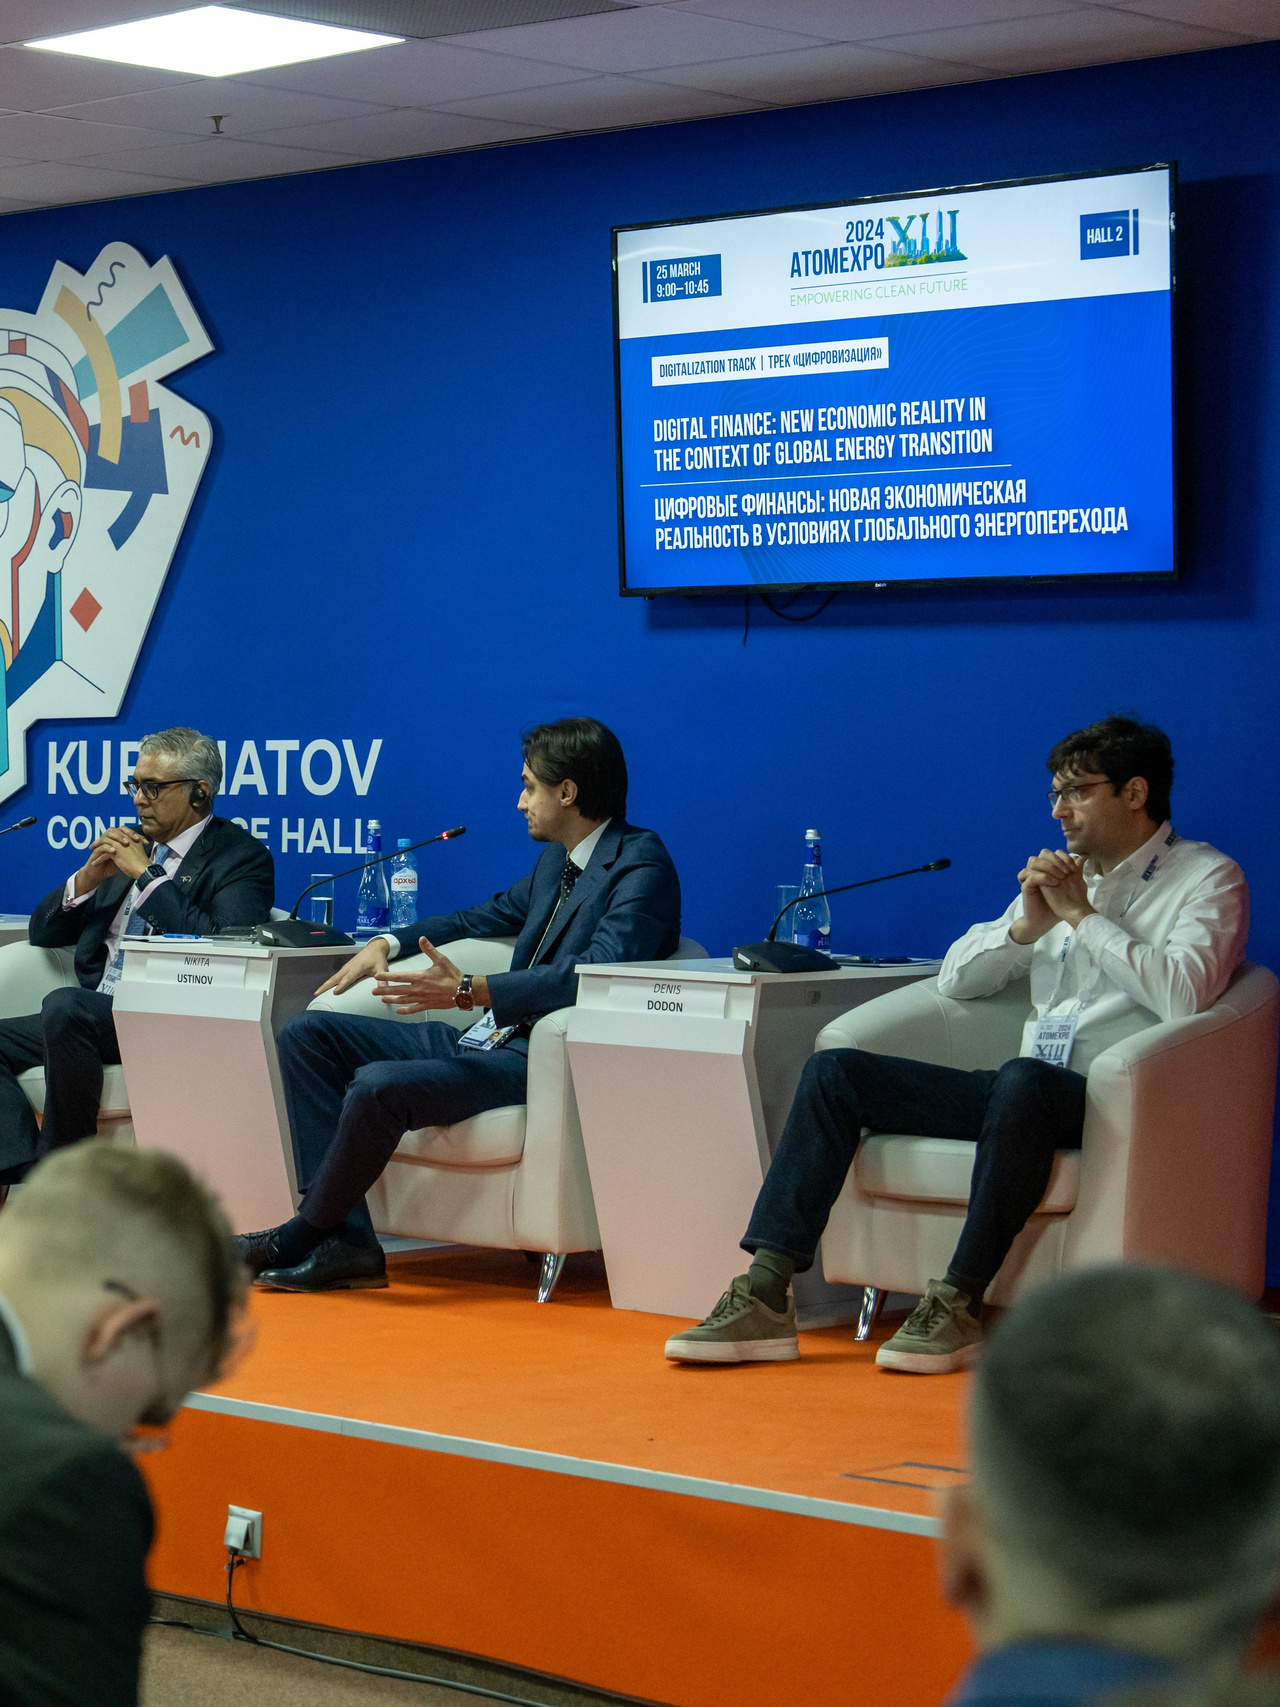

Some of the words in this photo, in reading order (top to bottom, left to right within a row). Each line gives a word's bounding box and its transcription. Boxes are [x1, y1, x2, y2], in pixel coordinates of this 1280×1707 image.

[846, 218, 885, 243] 2024
[1086, 226, 1114, 244] HALL
[1115, 225, 1123, 242] 2
[656, 264, 668, 280] 25
[670, 261, 701, 279] MARCH
[790, 242, 885, 278] ATOMEXPO
[790, 287, 873, 307] EMPOWERING
[875, 283, 916, 298] CLEAN
[920, 279, 968, 295] FUTURE
[659, 360, 726, 378] DIGITALIZATION
[728, 356, 756, 373] TRACK
[768, 353, 791, 369] ТРЕК
[793, 346, 882, 368] «ЦИФРОВИЗАЦИЯ»
[653, 417, 707, 442] DIGITAL
[710, 412, 776, 438] FINANCE:
[780, 408, 814, 433] NEW
[818, 403, 897, 431] ECONOMIC
[900, 397, 965, 426] REALITY
[969, 396, 986, 421] IN
[654, 448, 681, 472] THE
[685, 444, 749, 471] CONTEXT
[753, 442, 771, 466] OF
[775, 439, 832, 465] GLOBAL
[836, 434, 895, 461] ENERGY
[899, 428, 993, 458] TRANSITION
[655, 494, 738, 522] ЦИФРОВЫЕ
[741, 490, 825, 517] ФИНАНСЫ:
[829, 486, 880, 512] НОВАЯ
[884, 479, 1027, 510] ЭКОНОМИЧЕСКАЯ
[655, 525, 749, 550] РЕАЛЬНОСТЬ
[753, 523, 762, 546] В
[766, 520, 851, 546] УСЛОВИЯХ
[855, 513, 970, 542] ГЛОБАЛЬНОГО
[974, 507, 1128, 537] ЭНЕРГОПЕРЕХОДА
[48, 739, 383, 796] KUATOV
[282, 818, 368, 854] HALL
[184, 956, 210, 967] NIKITA
[177, 973, 213, 985] USTINOV
[653, 983, 682, 995] DENIS
[647, 1000, 683, 1012] DODON
[1038, 1031, 1070, 1040] ATOMEXPO
